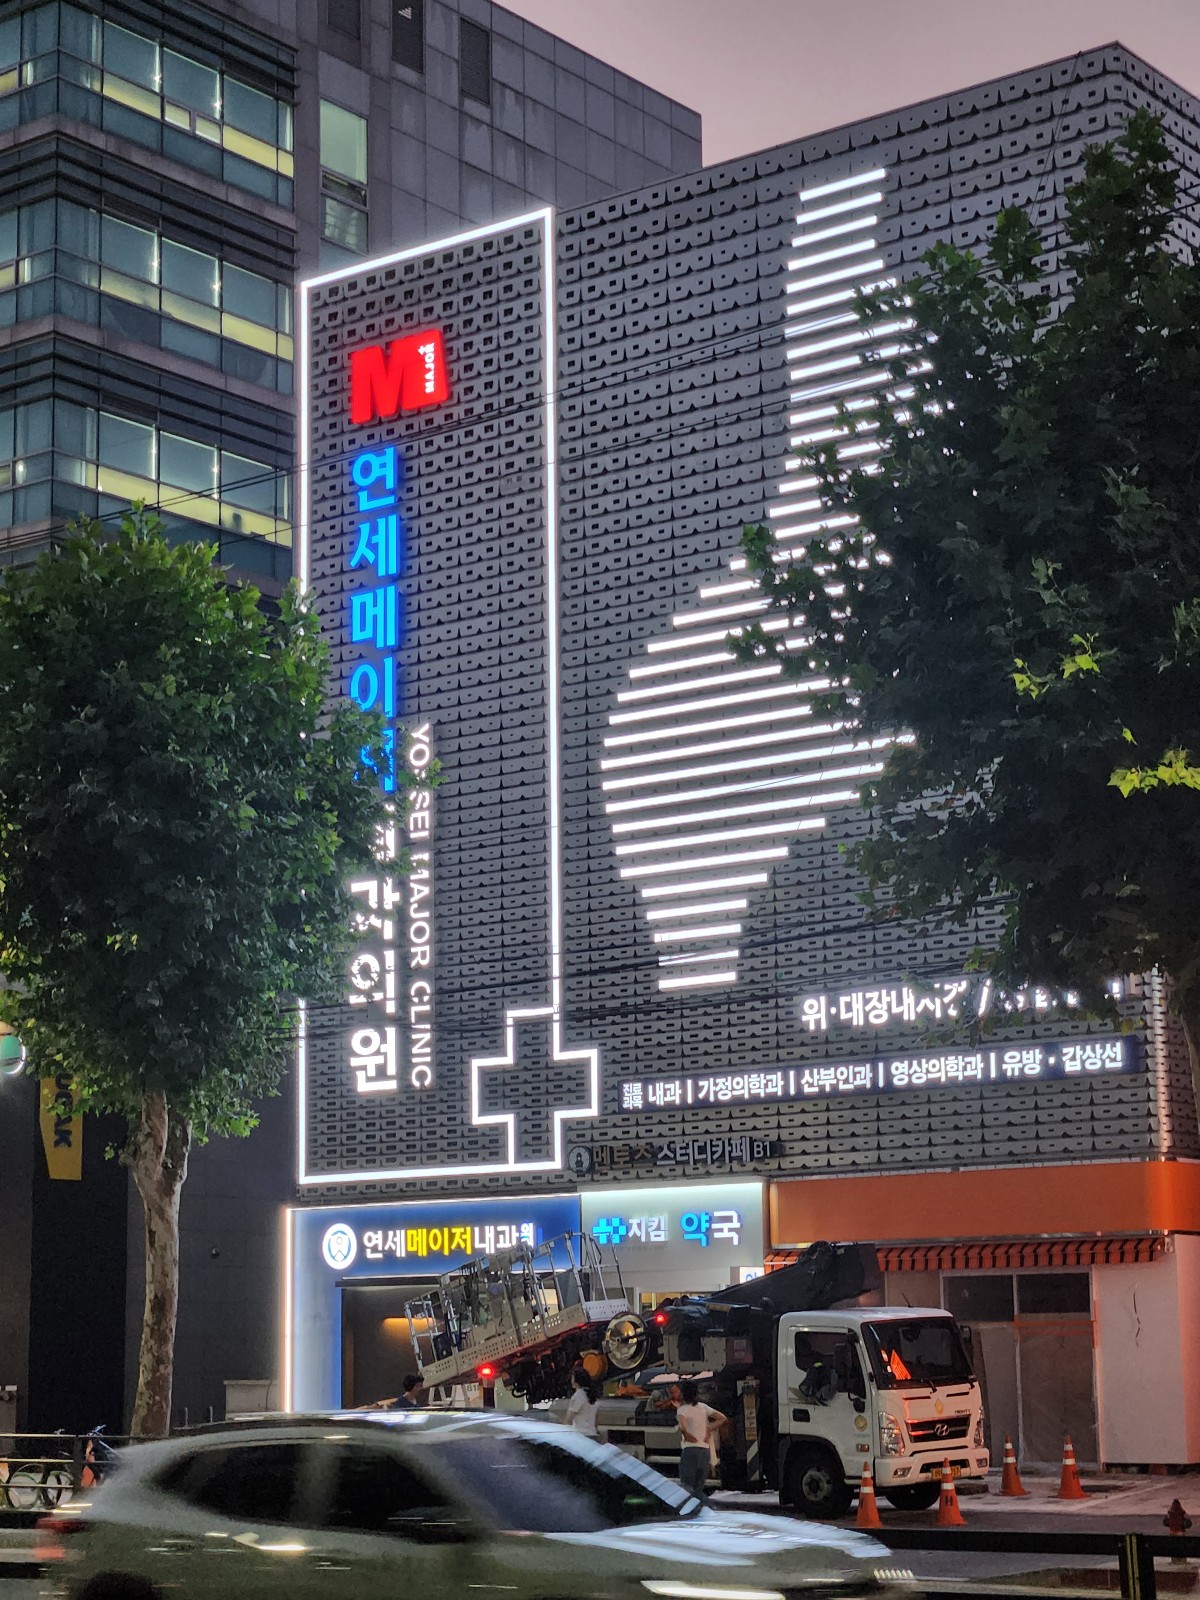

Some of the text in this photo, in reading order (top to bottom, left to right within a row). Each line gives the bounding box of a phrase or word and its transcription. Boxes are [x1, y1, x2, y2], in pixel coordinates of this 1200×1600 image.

[350, 329, 448, 424] M
[424, 342, 436, 394] MAJOR
[410, 980, 432, 1088] CLINIC
[648, 1080, 682, 1106] 내과
[697, 1071, 784, 1103] 가정의학과
[800, 1063, 873, 1094] 산부인과
[890, 1054, 984, 1086] 영상의학과
[753, 1140, 771, 1159] B1
[680, 1210, 742, 1247] 약국
